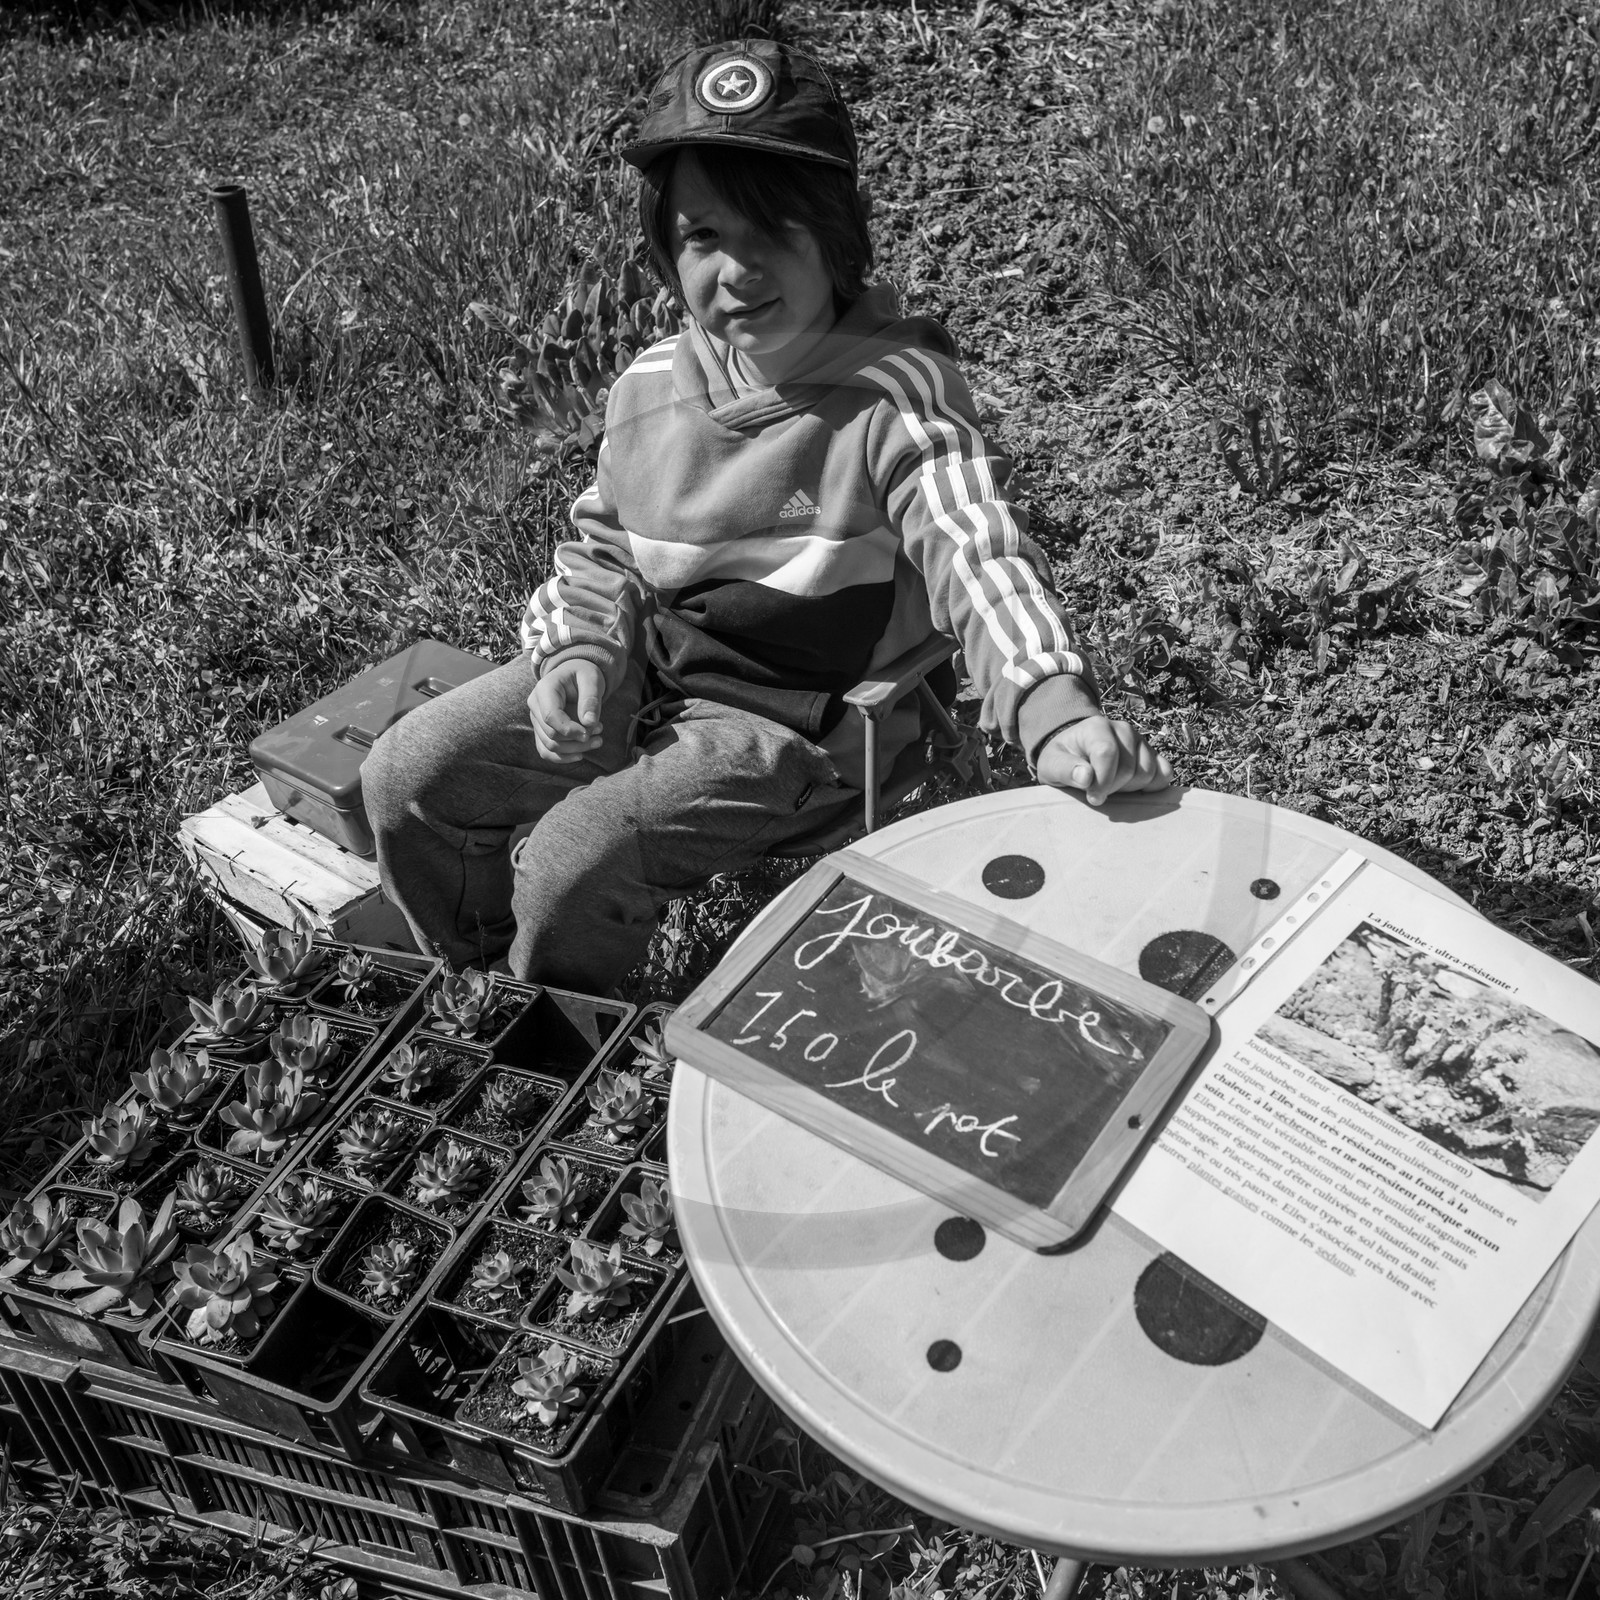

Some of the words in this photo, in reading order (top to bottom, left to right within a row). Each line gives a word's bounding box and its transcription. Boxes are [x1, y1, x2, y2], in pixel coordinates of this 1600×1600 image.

[779, 505, 821, 518] adidas
[1367, 912, 1381, 923] La
[1382, 919, 1428, 949] joubarbe
[1434, 948, 1512, 989] ultra-résistante
[1183, 1104, 1232, 1138] supportent
[1232, 1135, 1283, 1171] également
[1283, 1168, 1312, 1189] d'être
[1312, 1187, 1358, 1218] cultivées
[1358, 1216, 1373, 1228] en
[1373, 1225, 1419, 1258] situation
[1419, 1255, 1440, 1270] mi-
[1192, 1092, 1217, 1112] Elles
[1215, 1109, 1262, 1139] préfèrent
[1261, 1136, 1281, 1151] une
[1281, 1149, 1333, 1185] exposition
[1333, 1182, 1371, 1208] chaude
[1371, 1206, 1384, 1216] et
[1383, 1213, 1440, 1252] ensoleillée
[1440, 1250, 1468, 1270] mais
[1202, 1082, 1225, 1101] soin.
[1227, 1096, 1252, 1115] Leur
[1250, 1114, 1274, 1130] seul
[1274, 1127, 1316, 1156] véritable
[1316, 1154, 1356, 1180] ennemi
[1355, 1178, 1372, 1190] est
[1371, 1185, 1426, 1224] l'humidité
[1424, 1221, 1477, 1258] stagnante.
[1212, 1072, 1252, 1100] chaleur,
[1252, 1096, 1262, 1105] à
[1261, 1101, 1273, 1113] la
[1271, 1110, 1328, 1148] sécheresse,
[1330, 1145, 1342, 1155] et
[1342, 1152, 1357, 1164] ne
[1357, 1161, 1417, 1201] nécessitent
[1415, 1197, 1463, 1229] presque
[1463, 1226, 1500, 1252] aucun
[1222, 1062, 1265, 1093] rustiques.
[1268, 1088, 1295, 1109] Elles
[1294, 1106, 1319, 1123] sont
[1319, 1120, 1340, 1136] très
[1340, 1134, 1397, 1171] résistantes
[1397, 1168, 1413, 1181] au
[1413, 1176, 1445, 1201] froid,
[1446, 1196, 1456, 1206] à
[1456, 1201, 1468, 1214] la
[1232, 1050, 1251, 1065] Les
[1248, 1062, 1297, 1094] joubarbes
[1297, 1092, 1320, 1108] sont
[1320, 1105, 1338, 1118] des
[1336, 1116, 1375, 1140] plantes
[1373, 1137, 1459, 1191] particulièrement
[1459, 1188, 1504, 1218] robustes
[1505, 1216, 1517, 1226] et
[1244, 1038, 1292, 1070] Joubarbes
[1292, 1068, 1305, 1078] en
[1305, 1074, 1330, 1092] fleur
[1415, 1139, 1473, 1178] flickr.com)
[1171, 1116, 1219, 1149] ombragée.
[1221, 1145, 1271, 1182] Placez-les
[1271, 1179, 1296, 1198] dans
[1296, 1194, 1318, 1212] tout
[1318, 1208, 1342, 1227] type
[1342, 1224, 1357, 1236] de
[1356, 1234, 1376, 1249] sol
[1375, 1244, 1399, 1265] bien
[1400, 1262, 1436, 1291] drainé,
[1185, 1160, 1222, 1190] plantes
[1219, 1185, 1259, 1213] grasses
[1260, 1209, 1298, 1237] comme
[1298, 1232, 1315, 1248] les
[1314, 1246, 1356, 1277] sedums.
[1191, 1145, 1209, 1159] sec
[1208, 1157, 1223, 1169] ou
[1223, 1166, 1242, 1182] très
[1240, 1179, 1278, 1206] pauvre.
[1280, 1202, 1308, 1224] Elles
[1307, 1221, 1364, 1261] s'associent
[1363, 1257, 1384, 1274] très
[1385, 1269, 1410, 1291] bien
[1410, 1289, 1437, 1308] avec
